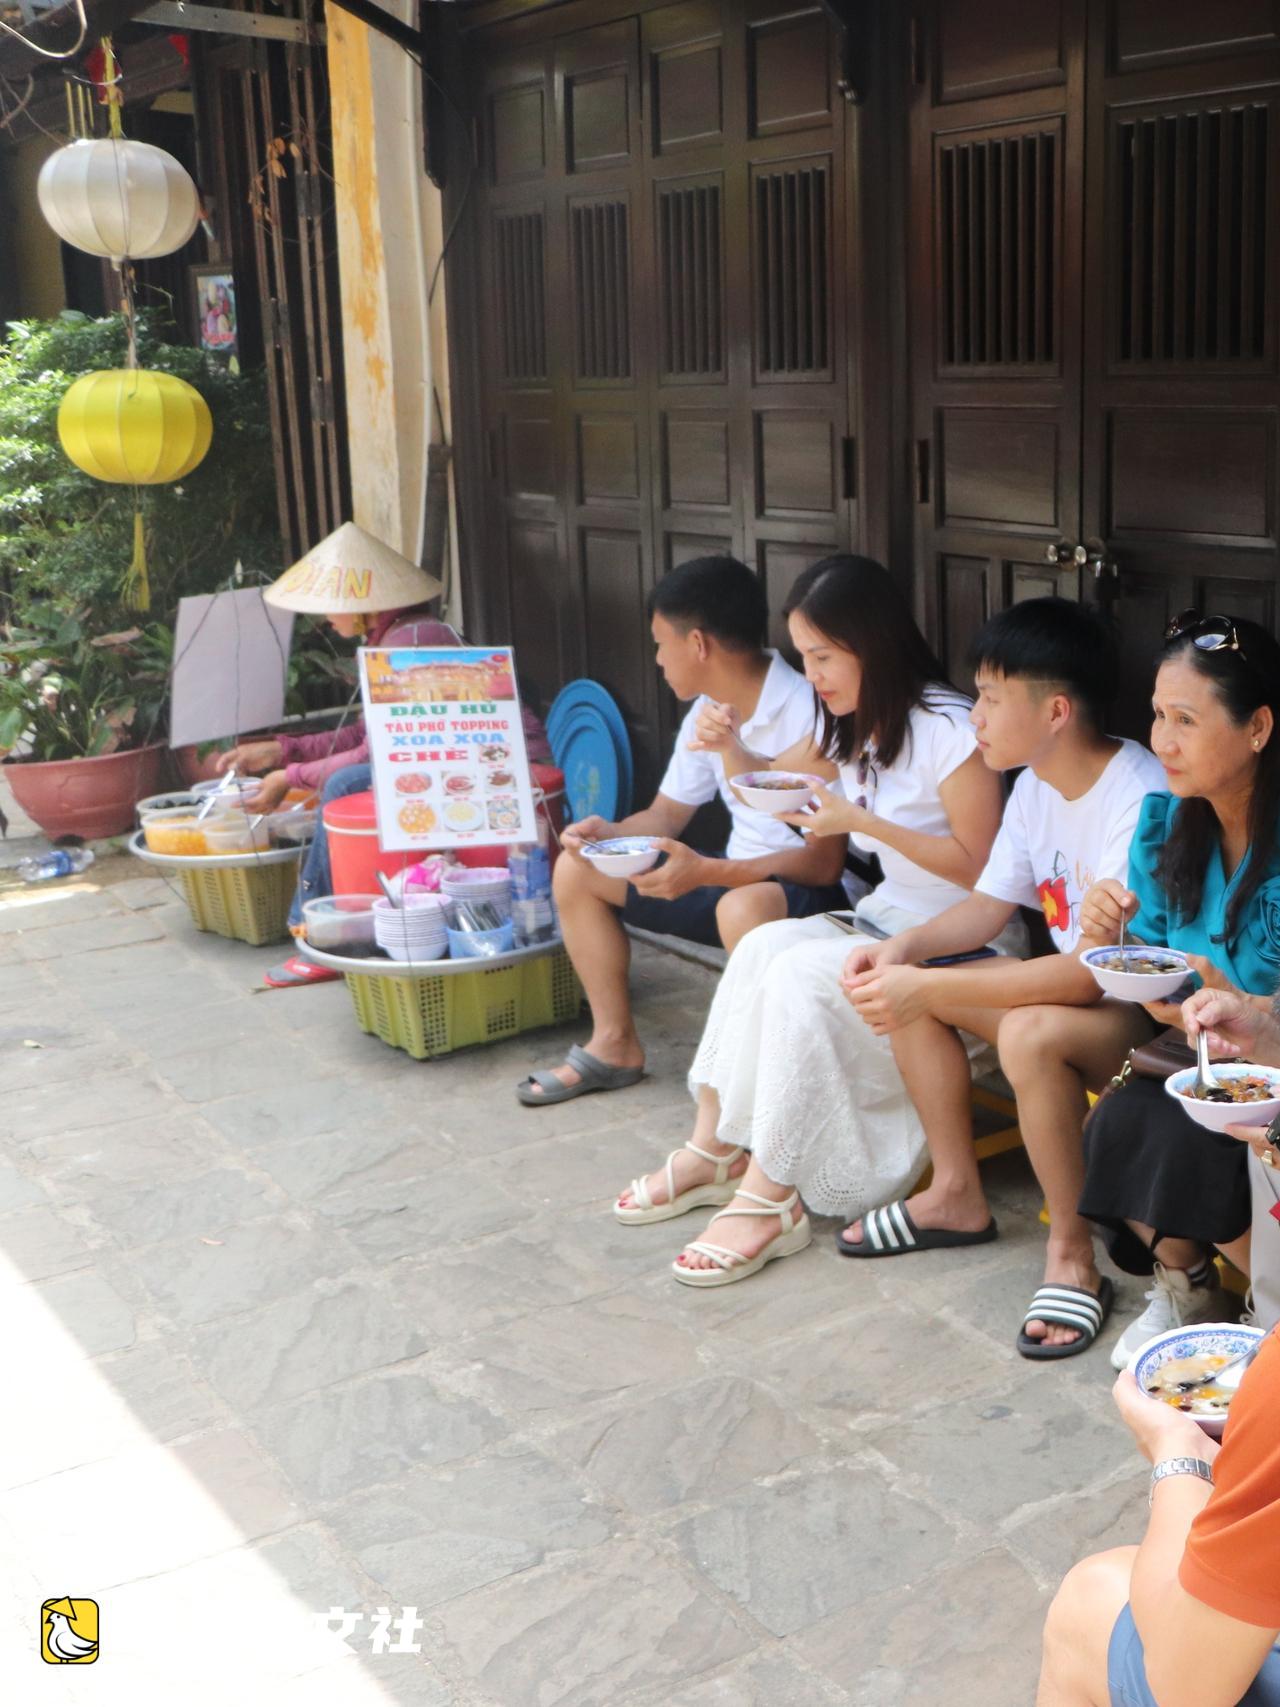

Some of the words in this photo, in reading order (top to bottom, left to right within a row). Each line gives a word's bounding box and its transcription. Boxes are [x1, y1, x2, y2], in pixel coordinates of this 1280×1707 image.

[450, 719, 509, 731] TOPPING
[391, 733, 444, 746] XOA
[454, 732, 505, 744] XOA
[388, 747, 468, 762] CHÈ
